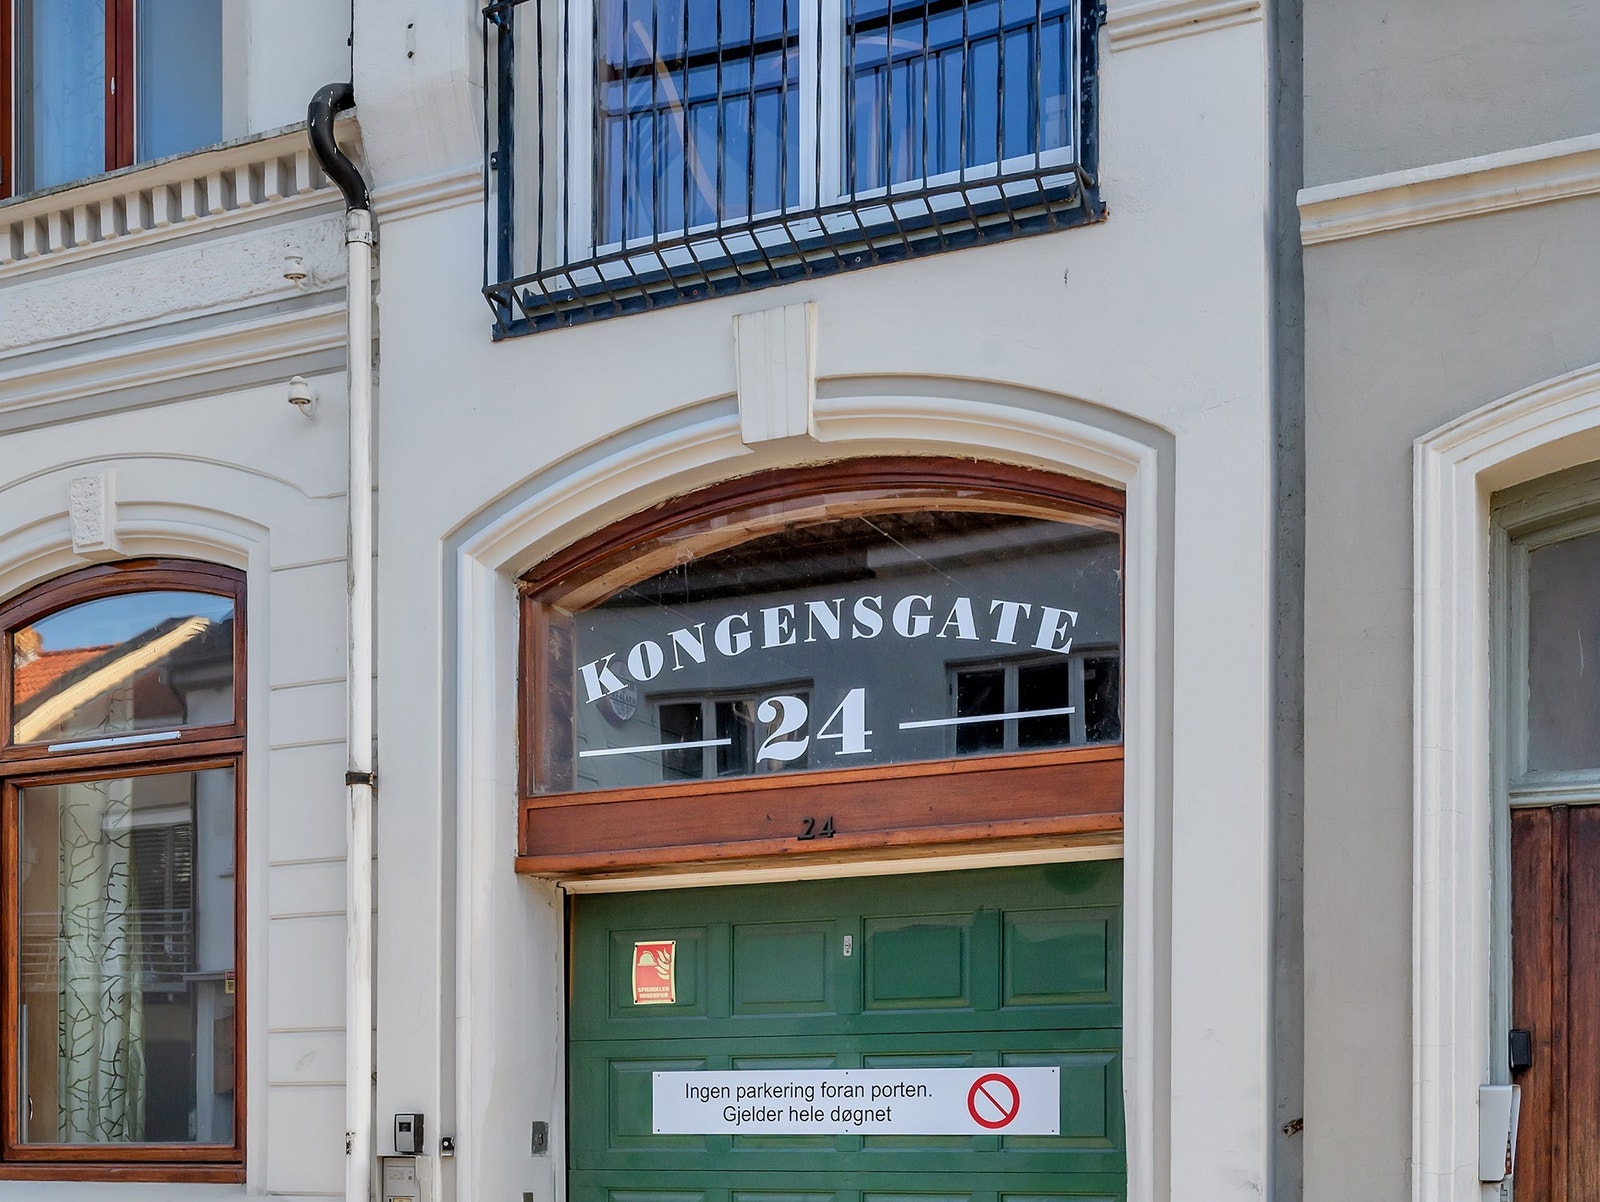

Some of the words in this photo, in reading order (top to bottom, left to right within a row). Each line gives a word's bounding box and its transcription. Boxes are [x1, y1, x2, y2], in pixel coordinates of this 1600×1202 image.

[578, 595, 1079, 704] KONGENSGATE
[756, 687, 873, 764] 24
[797, 816, 836, 841] 24
[685, 1082, 730, 1102] Ingen
[736, 1082, 815, 1102] parkering
[820, 1081, 865, 1098] foran
[871, 1082, 933, 1101] porten.
[723, 1105, 784, 1126] Gjelder
[789, 1105, 825, 1122] hele
[830, 1105, 892, 1126] døgnet
